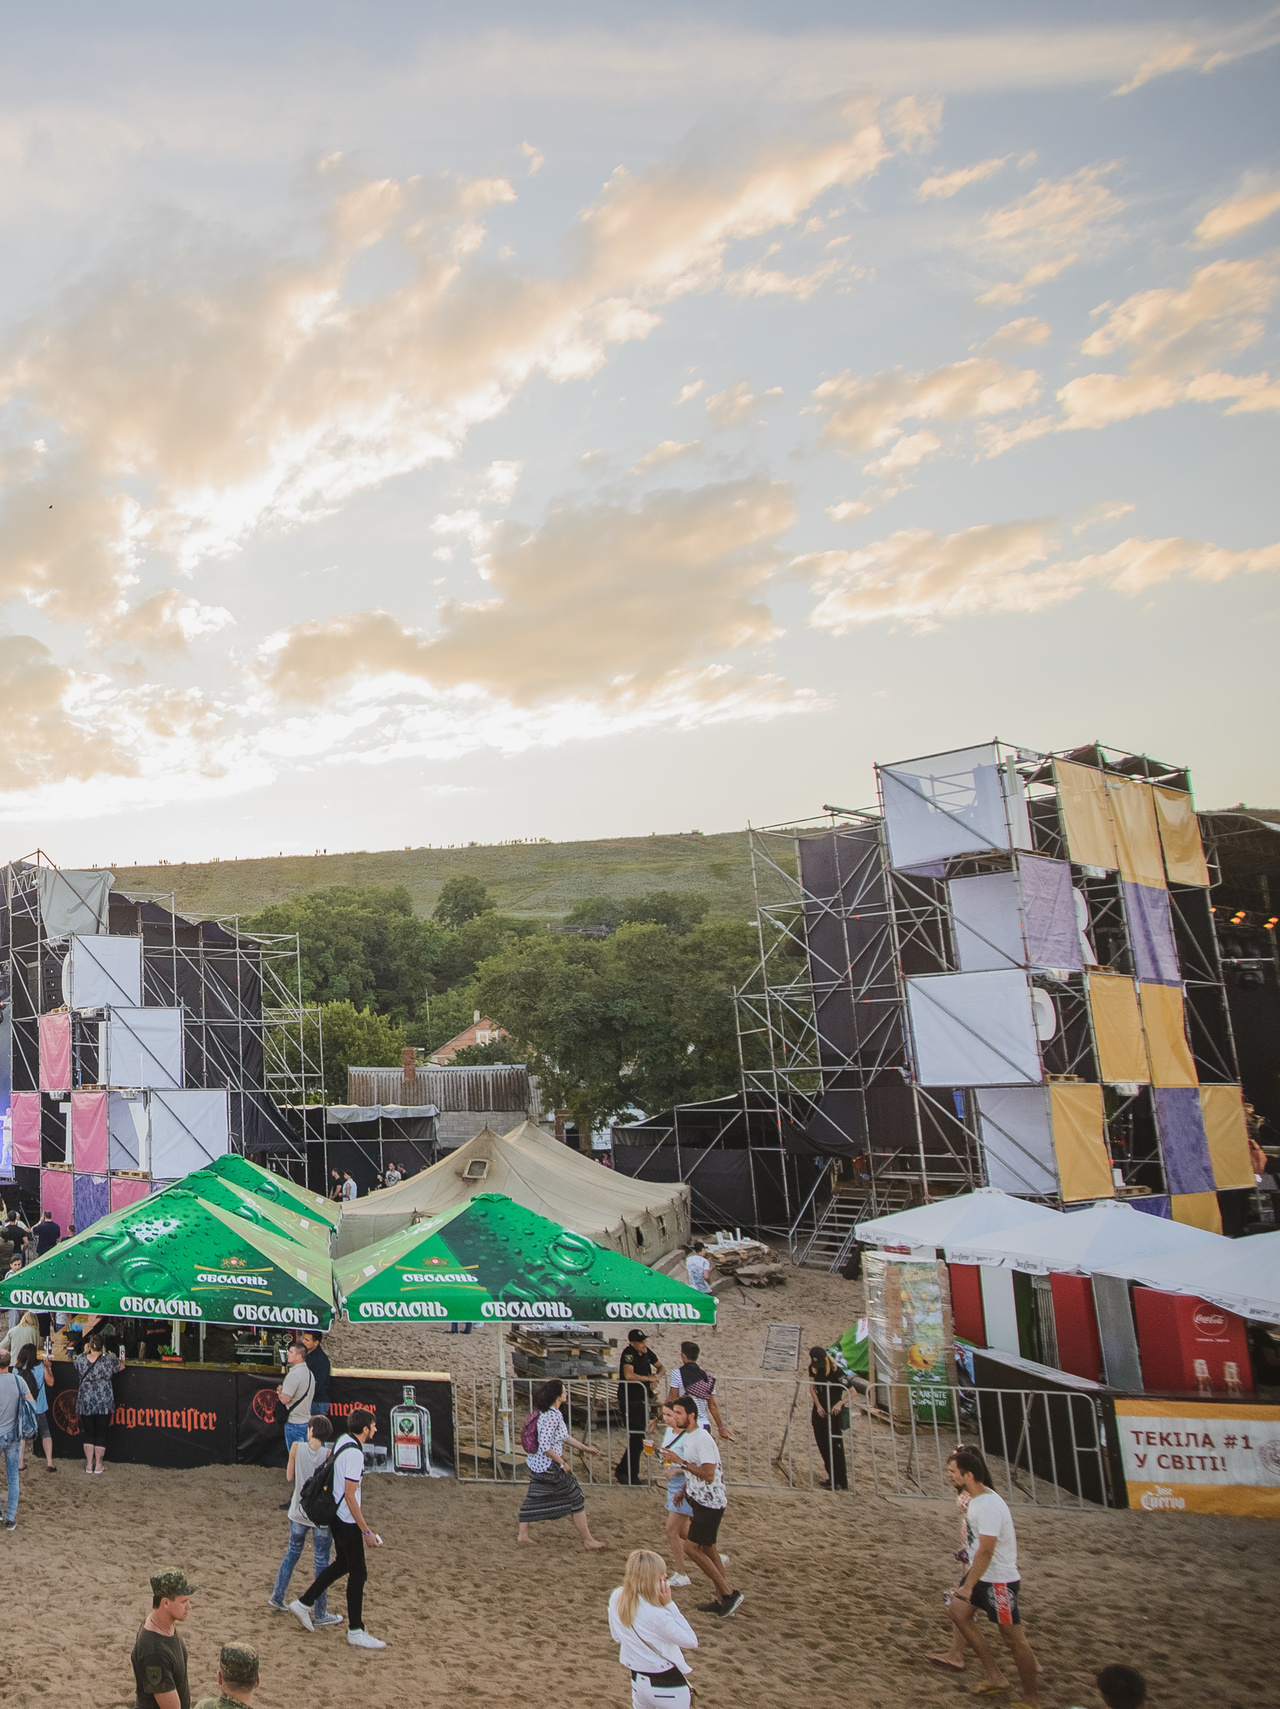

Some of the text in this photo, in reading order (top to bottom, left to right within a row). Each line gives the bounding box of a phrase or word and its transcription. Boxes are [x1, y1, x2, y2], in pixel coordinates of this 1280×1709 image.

[9, 1289, 91, 1310] ОБОЛОНЬ
[119, 1296, 203, 1318] ОБОЛОНЬ
[233, 1303, 320, 1326] ОБОЛОНЬ
[358, 1301, 449, 1319] ОБОЛОНЬ
[481, 1301, 573, 1319] ОБОЛОНЬ
[606, 1302, 702, 1320] ОБОЛОНЬ
[1130, 1430, 1254, 1450] ТЕКІЛА #1
[1133, 1453, 1228, 1472] У СВІТІ!
[1141, 1491, 1186, 1511] Cuervo
